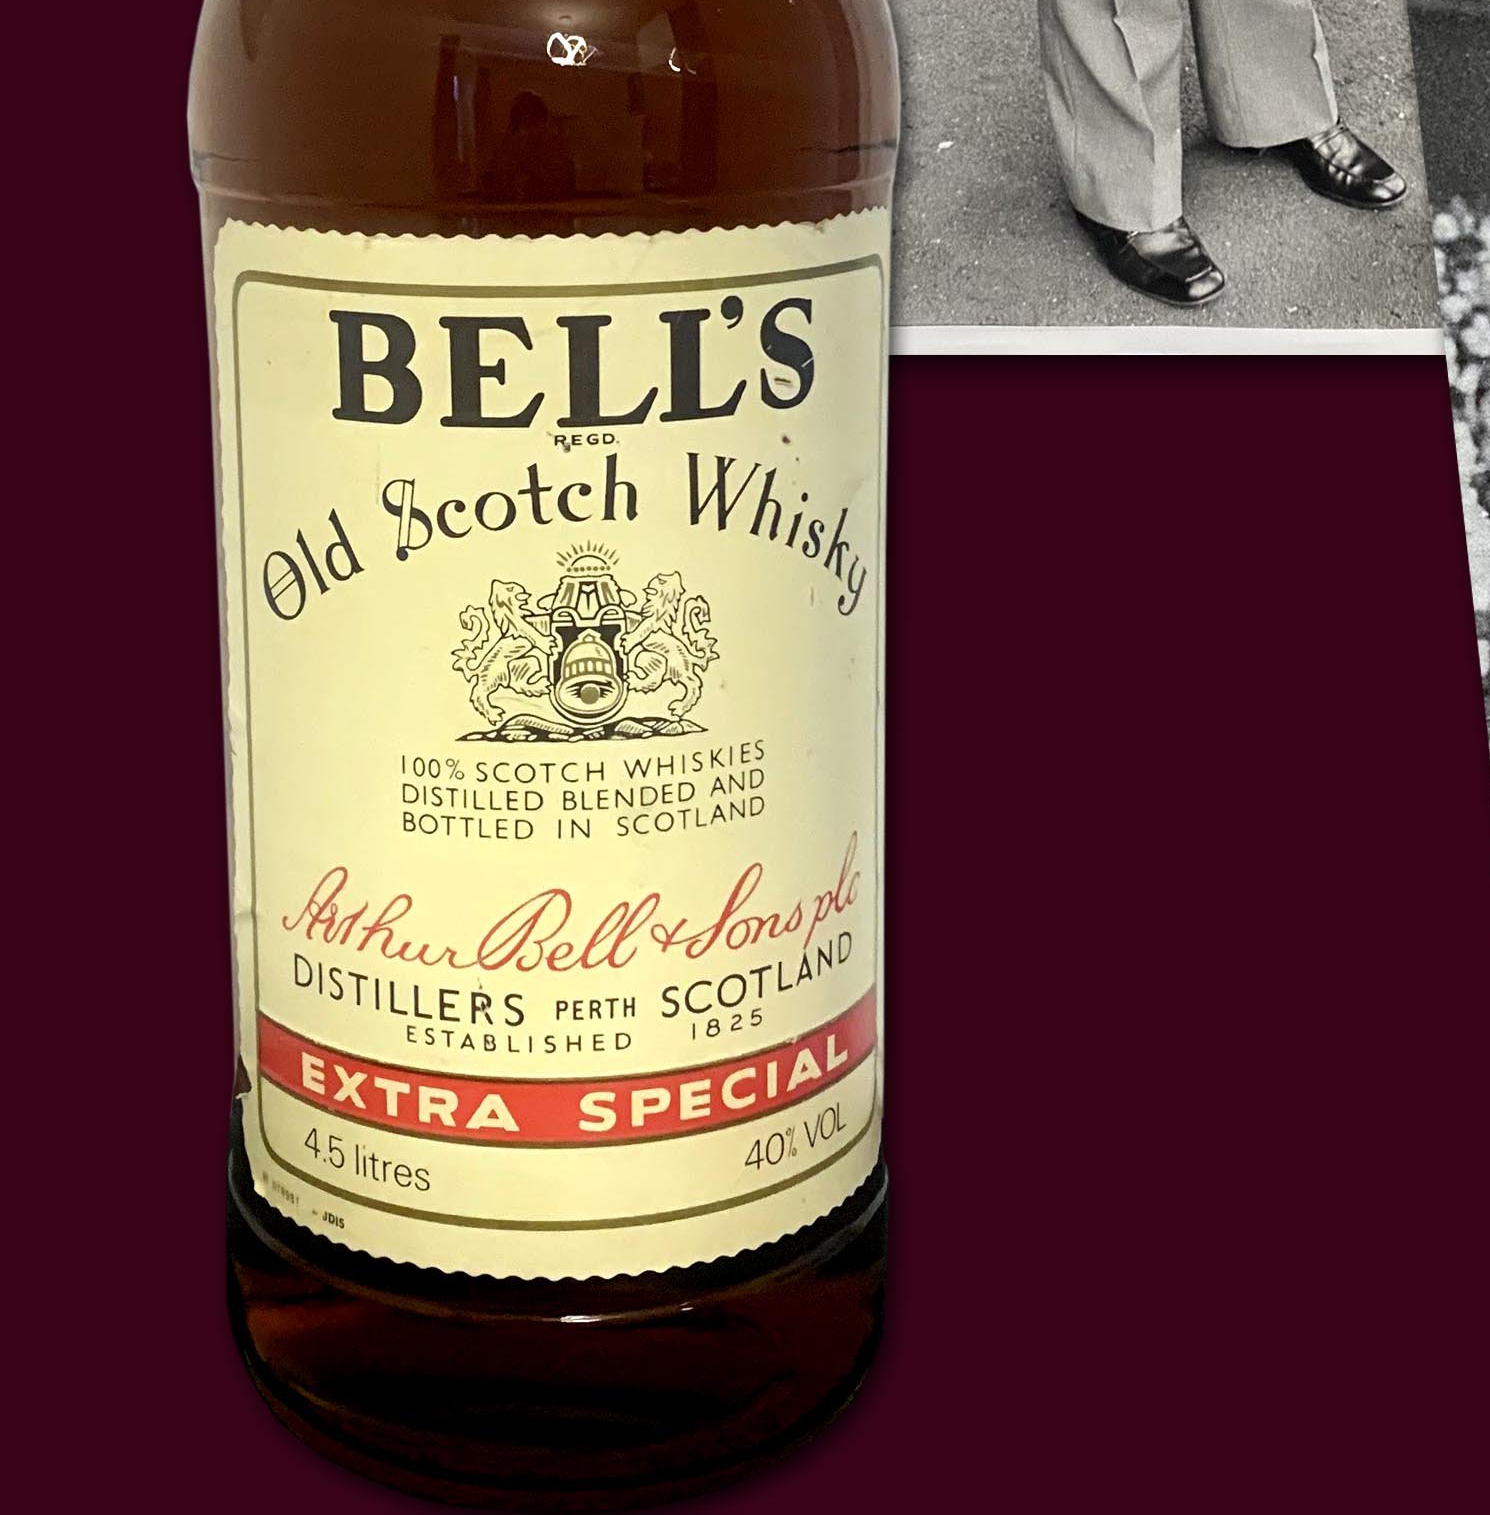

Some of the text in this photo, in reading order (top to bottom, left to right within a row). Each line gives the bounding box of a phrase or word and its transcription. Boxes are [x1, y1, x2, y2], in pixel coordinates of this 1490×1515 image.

[329, 295, 816, 428] BELL'S
[263, 452, 868, 621] Old Scotch Whisky
[401, 739, 765, 784] 100% SCOTCH WHISKIES
[401, 768, 765, 811] DISTILLED BLENDED AND
[402, 795, 765, 840] BOTTLED IN SCOTLAND
[282, 866, 478, 969] Arthur
[475, 888, 661, 972] Bell
[683, 862, 804, 960] Sons
[803, 830, 861, 949] plc
[293, 931, 854, 1027] DISTILLERS PERTH SCOTLAND
[406, 1009, 765, 1054] ESTABLISHED 1825
[301, 1034, 849, 1133] EXTRA SPECIAL
[304, 1127, 346, 1170] 4.5
[354, 1144, 432, 1193] litres
[744, 1102, 847, 1171] 40% VOL
